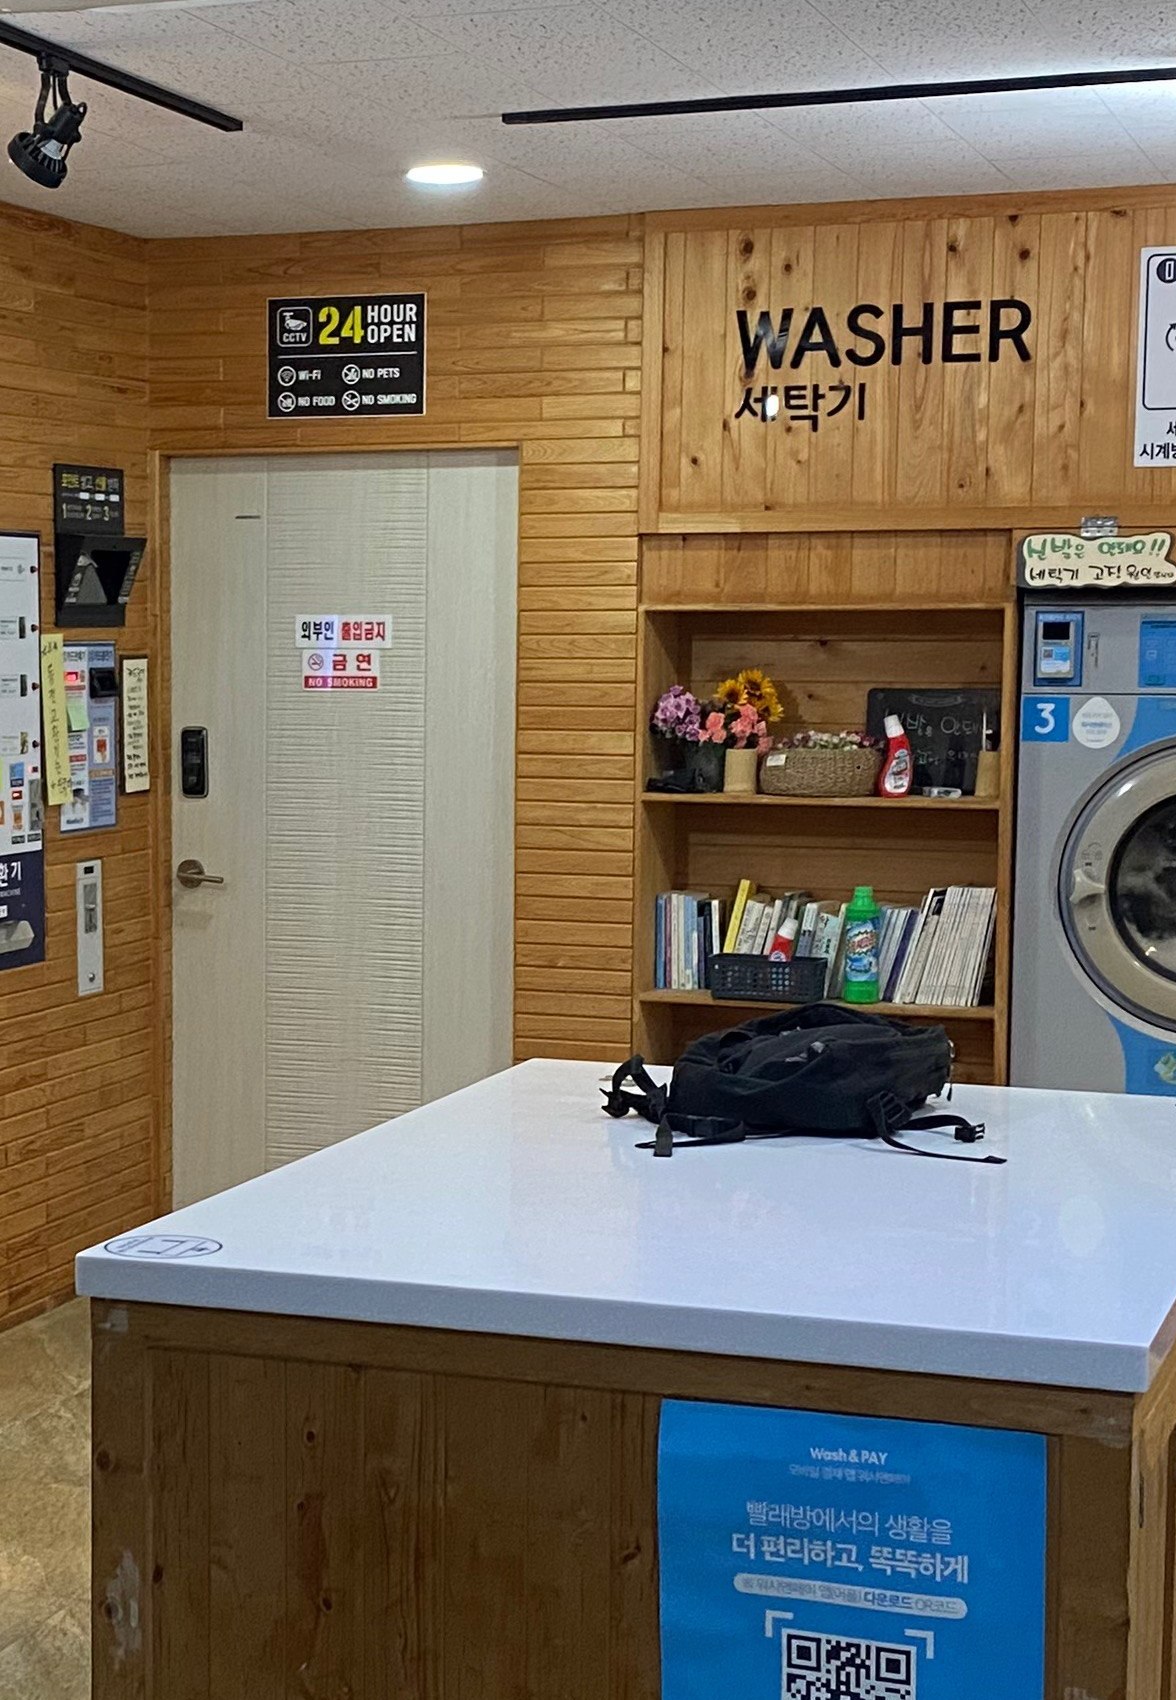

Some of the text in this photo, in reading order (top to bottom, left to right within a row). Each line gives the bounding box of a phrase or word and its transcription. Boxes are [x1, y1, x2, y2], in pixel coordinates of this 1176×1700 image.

[318, 303, 417, 345] 24 HOUR
[367, 324, 416, 344] OPEN
[736, 298, 1032, 370] WASHER
[282, 332, 307, 342] CCTV
[362, 368, 400, 379] NO PETS
[297, 396, 336, 406] NO FOOD
[362, 394, 417, 405] NO SMOKING
[734, 382, 866, 432] 세탁기
[301, 621, 386, 641] 외부인 출입금지
[332, 653, 371, 671] 금 연
[308, 678, 373, 688] NO SMOKING
[1035, 703, 1056, 735] 3
[746, 1500, 953, 1545] 빨래방에서의 생활을
[732, 1533, 969, 1584] 더 편리하고, 똑똑하게
[863, 1591, 913, 1610] 다운로드
